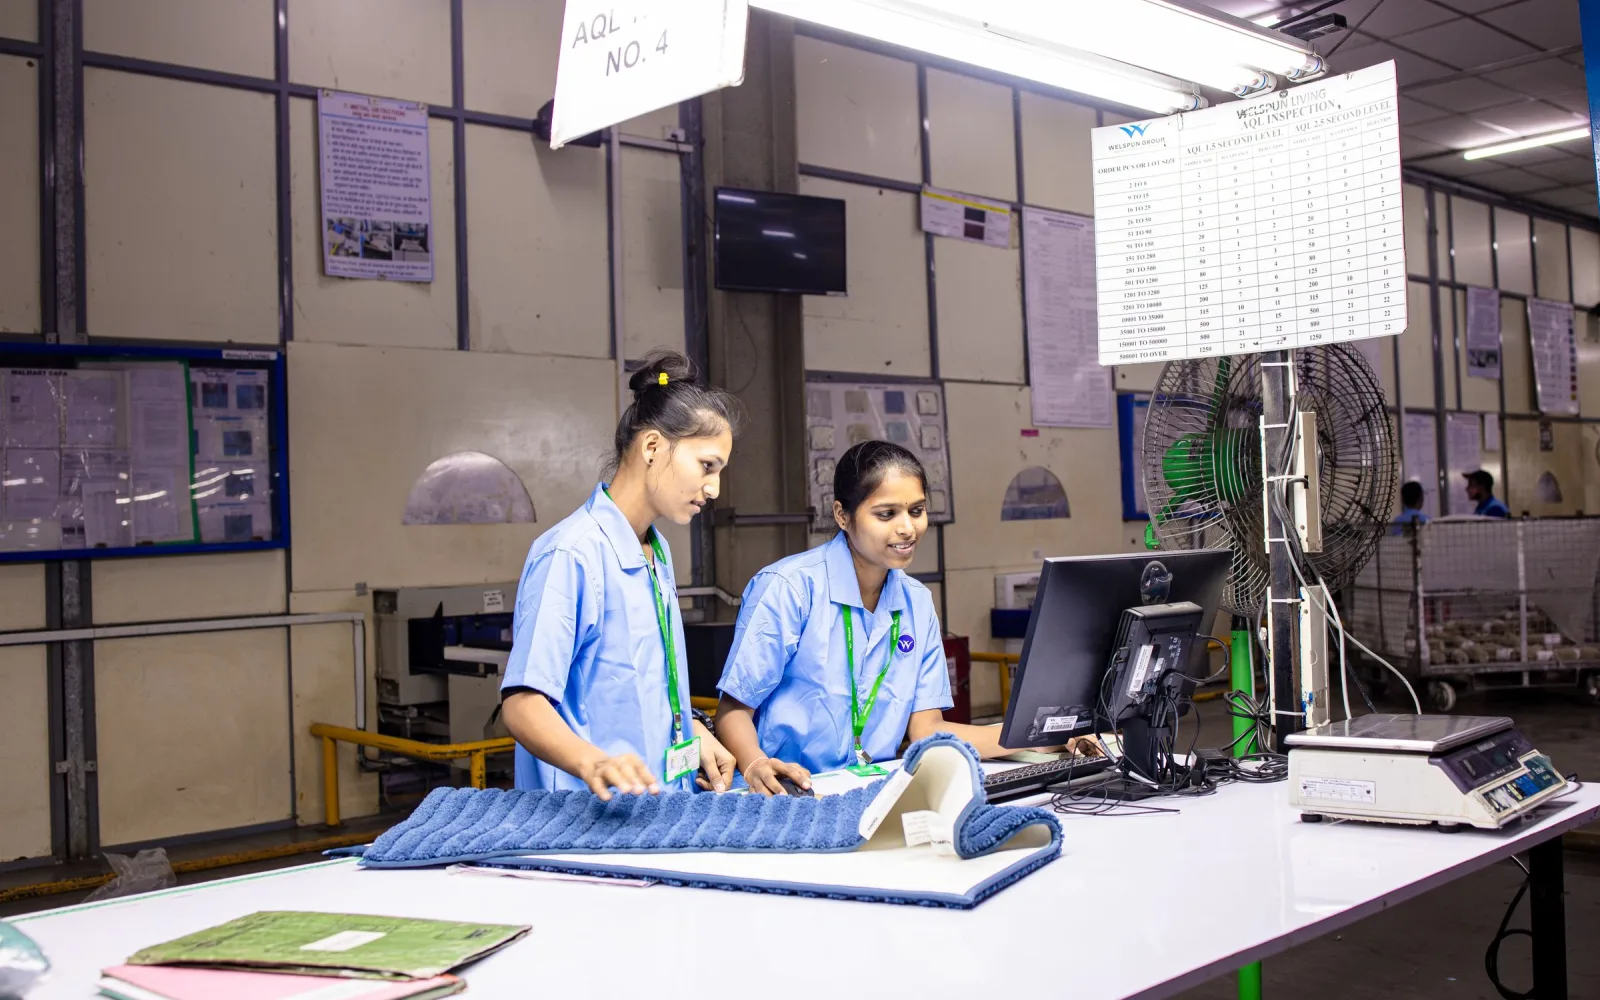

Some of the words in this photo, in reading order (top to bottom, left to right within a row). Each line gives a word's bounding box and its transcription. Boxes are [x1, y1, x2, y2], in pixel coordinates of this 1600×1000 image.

[572, 8, 620, 48] AQL
[606, 41, 645, 76] NO.
[655, 29, 668, 54] 4
[1291, 89, 1326, 106] LIVING
[1241, 117, 1264, 130] AQL
[1295, 122, 1310, 132] AQL
[1314, 118, 1324, 128] 2.5
[1326, 109, 1362, 124] SECOND
[1363, 101, 1391, 115] LEVEL
[1108, 141, 1141, 151] WELSPUN
[1187, 145, 1203, 155] AQL
[1206, 142, 1216, 151] 1.5
[1217, 135, 1253, 148] SECOND
[1255, 128, 1283, 141] LEVEL
[1098, 167, 1121, 175] ORDER
[1308, 241, 1316, 249] 50
[1308, 267, 1318, 275] 125
[1308, 280, 1319, 288] 200
[1383, 268, 1389, 276] 11
[1199, 308, 1210, 316] 315
[1309, 293, 1319, 302] 315
[1309, 307, 1320, 315] 500
[1309, 320, 1320, 328] 800
[1348, 315, 1354, 323] 21
[1384, 309, 1391, 317] 22
[1309, 333, 1322, 341] 1250
[1384, 323, 1391, 331] 22
